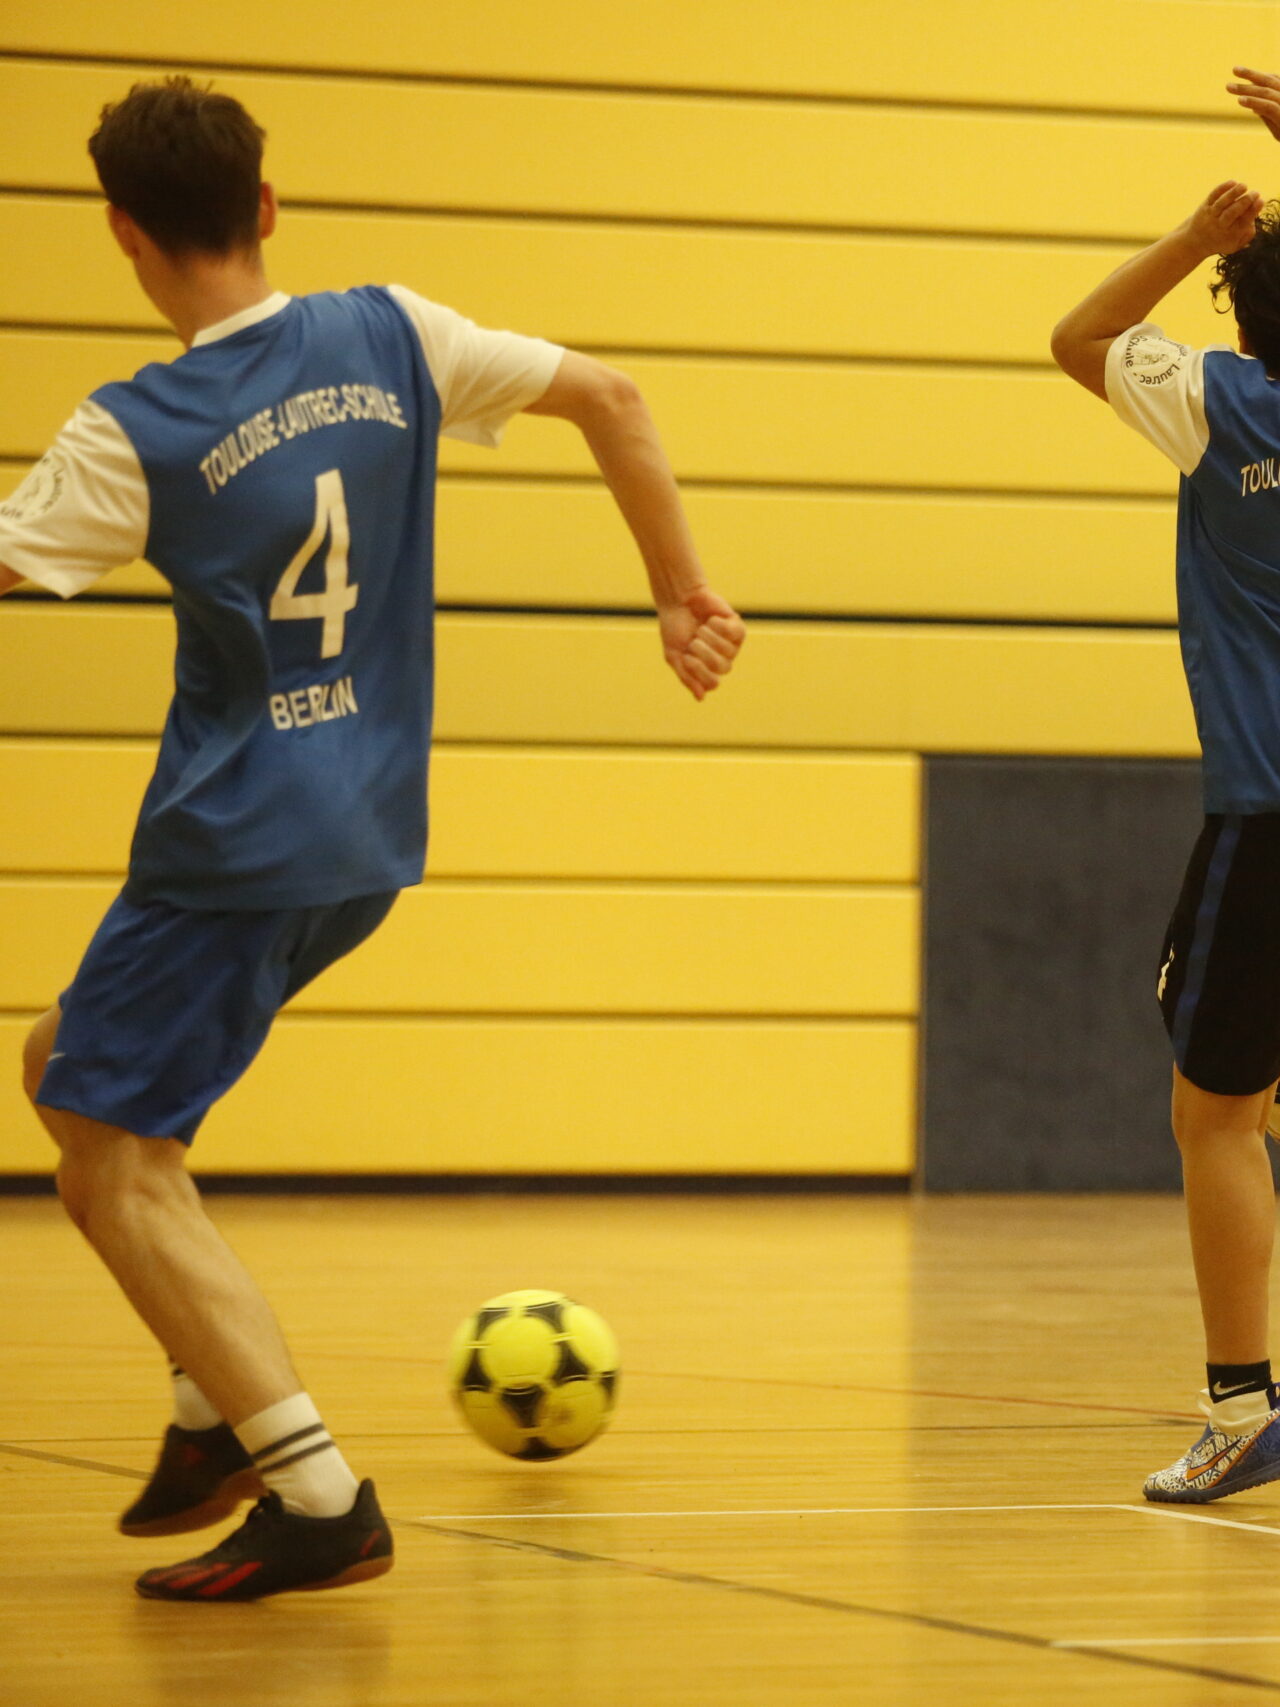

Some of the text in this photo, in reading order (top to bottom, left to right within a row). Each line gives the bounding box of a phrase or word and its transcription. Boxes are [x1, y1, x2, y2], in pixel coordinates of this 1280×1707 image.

[1139, 363, 1180, 385] Lautrec
[269, 467, 359, 660] 4
[269, 676, 359, 730] BERLIN
